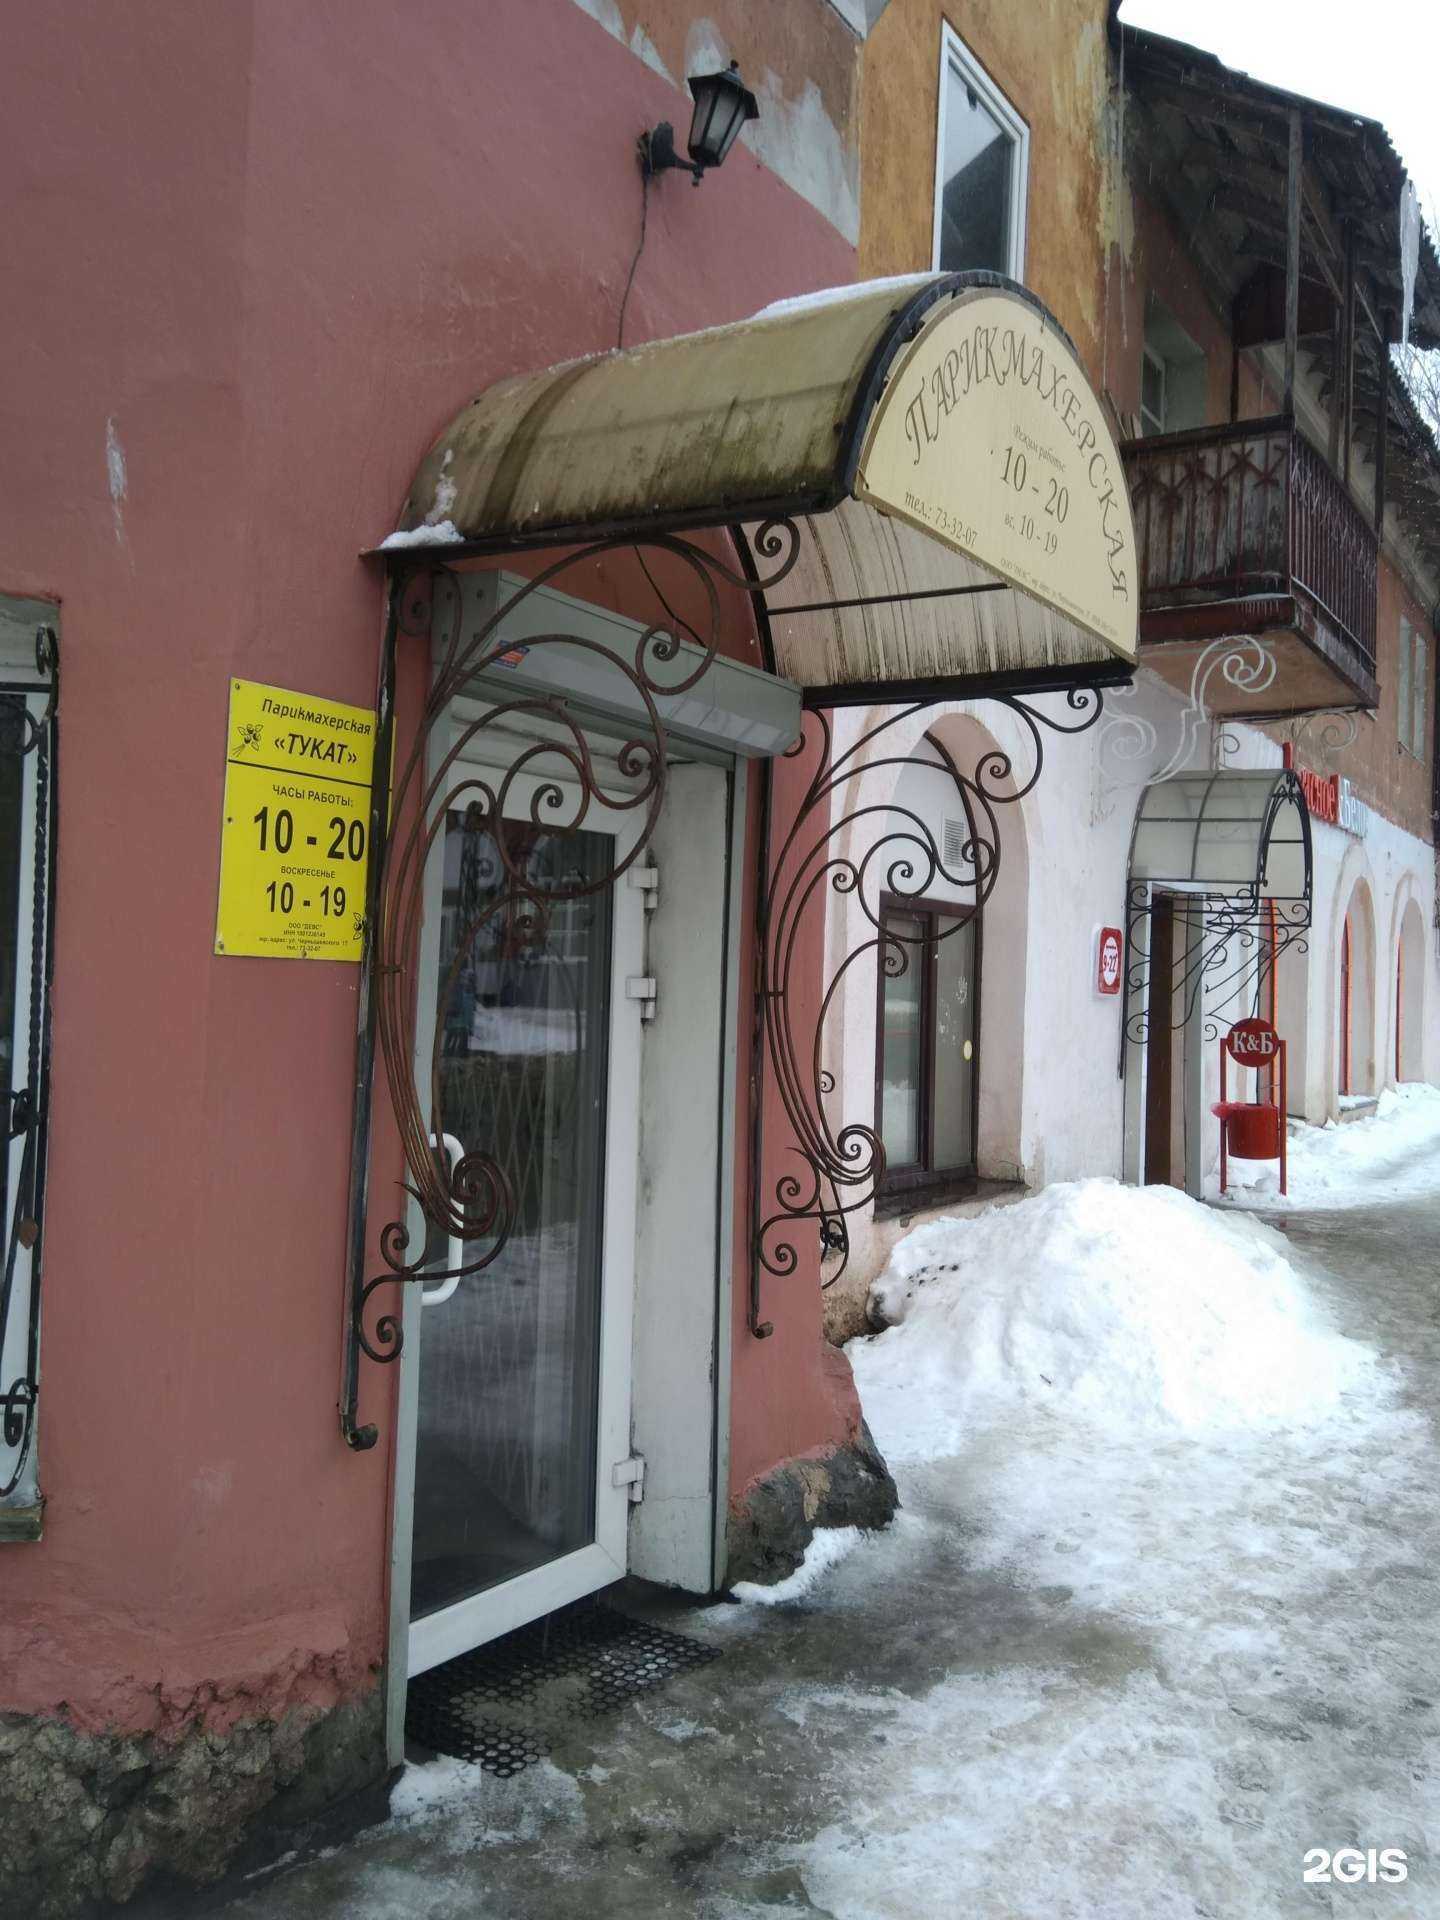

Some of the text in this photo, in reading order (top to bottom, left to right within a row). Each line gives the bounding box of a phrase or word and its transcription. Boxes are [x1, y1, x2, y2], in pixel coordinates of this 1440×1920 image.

[904, 325, 1129, 603] ПАРИКМАХЕРСКАЯ
[1000, 446, 1027, 492] 10
[1044, 477, 1069, 524] 20
[935, 506, 978, 546] 73-32-07
[1020, 515, 1034, 541] 10
[1044, 531, 1059, 554] 19
[261, 698, 371, 736] Парикмахерская
[274, 732, 357, 765] «ТУКАТ»
[272, 784, 353, 808] ЧАСЫ РАБОТЫ:
[254, 806, 365, 862] 10 - 20
[280, 865, 336, 879] ВОСКРЕСЕНЬЕ
[266, 880, 294, 914] 10
[319, 885, 346, 917] 19
[1231, 1031, 1274, 1054] К&Б
